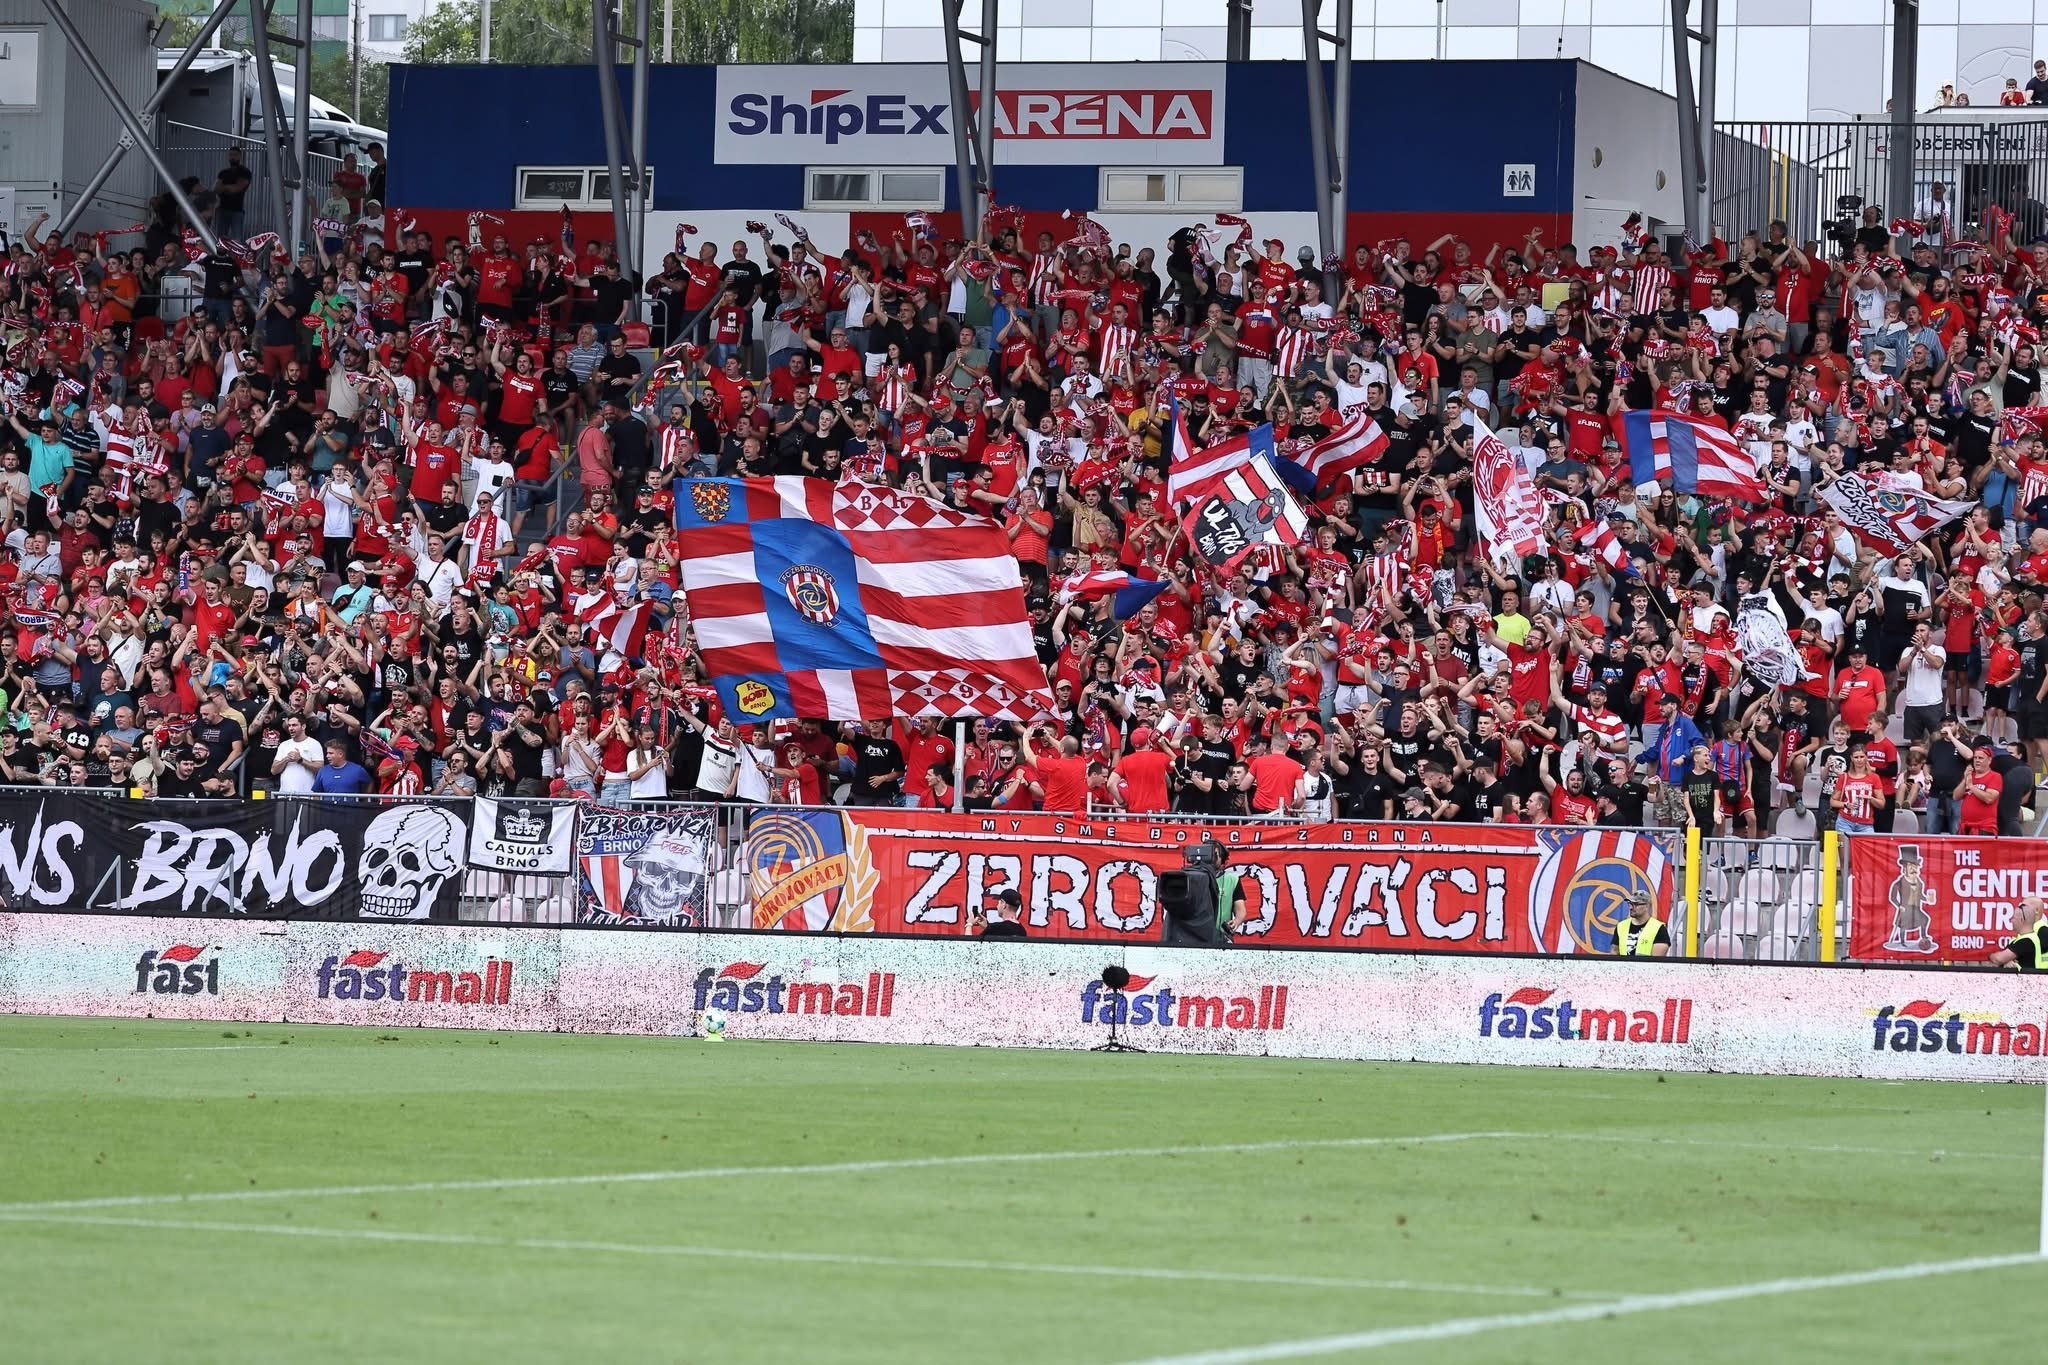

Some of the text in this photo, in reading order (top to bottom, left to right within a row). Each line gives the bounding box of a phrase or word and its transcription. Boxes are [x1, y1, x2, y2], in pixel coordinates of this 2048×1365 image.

[728, 90, 949, 144] ShipEx
[791, 565, 833, 583] ZBROJOVKA
[750, 702, 768, 711] BRNO
[603, 839, 642, 853] BRNO
[980, 818, 1433, 845] MY SME BORCI Z BRNA
[98, 804, 346, 914] BRNO
[484, 840, 554, 856] CASUALS
[495, 855, 540, 870] BRNO
[1953, 849, 1981, 866] THE
[903, 849, 1507, 942] ZBROOVÁCI
[1952, 868, 2048, 899] GENTLE
[1951, 935, 1985, 950] BRNO
[317, 951, 513, 1005] fastmall
[692, 961, 896, 1017] fastmall
[1080, 975, 1288, 1031] fastmall
[1478, 987, 1693, 1044] fastmall
[1872, 1000, 2048, 1057] fastma
